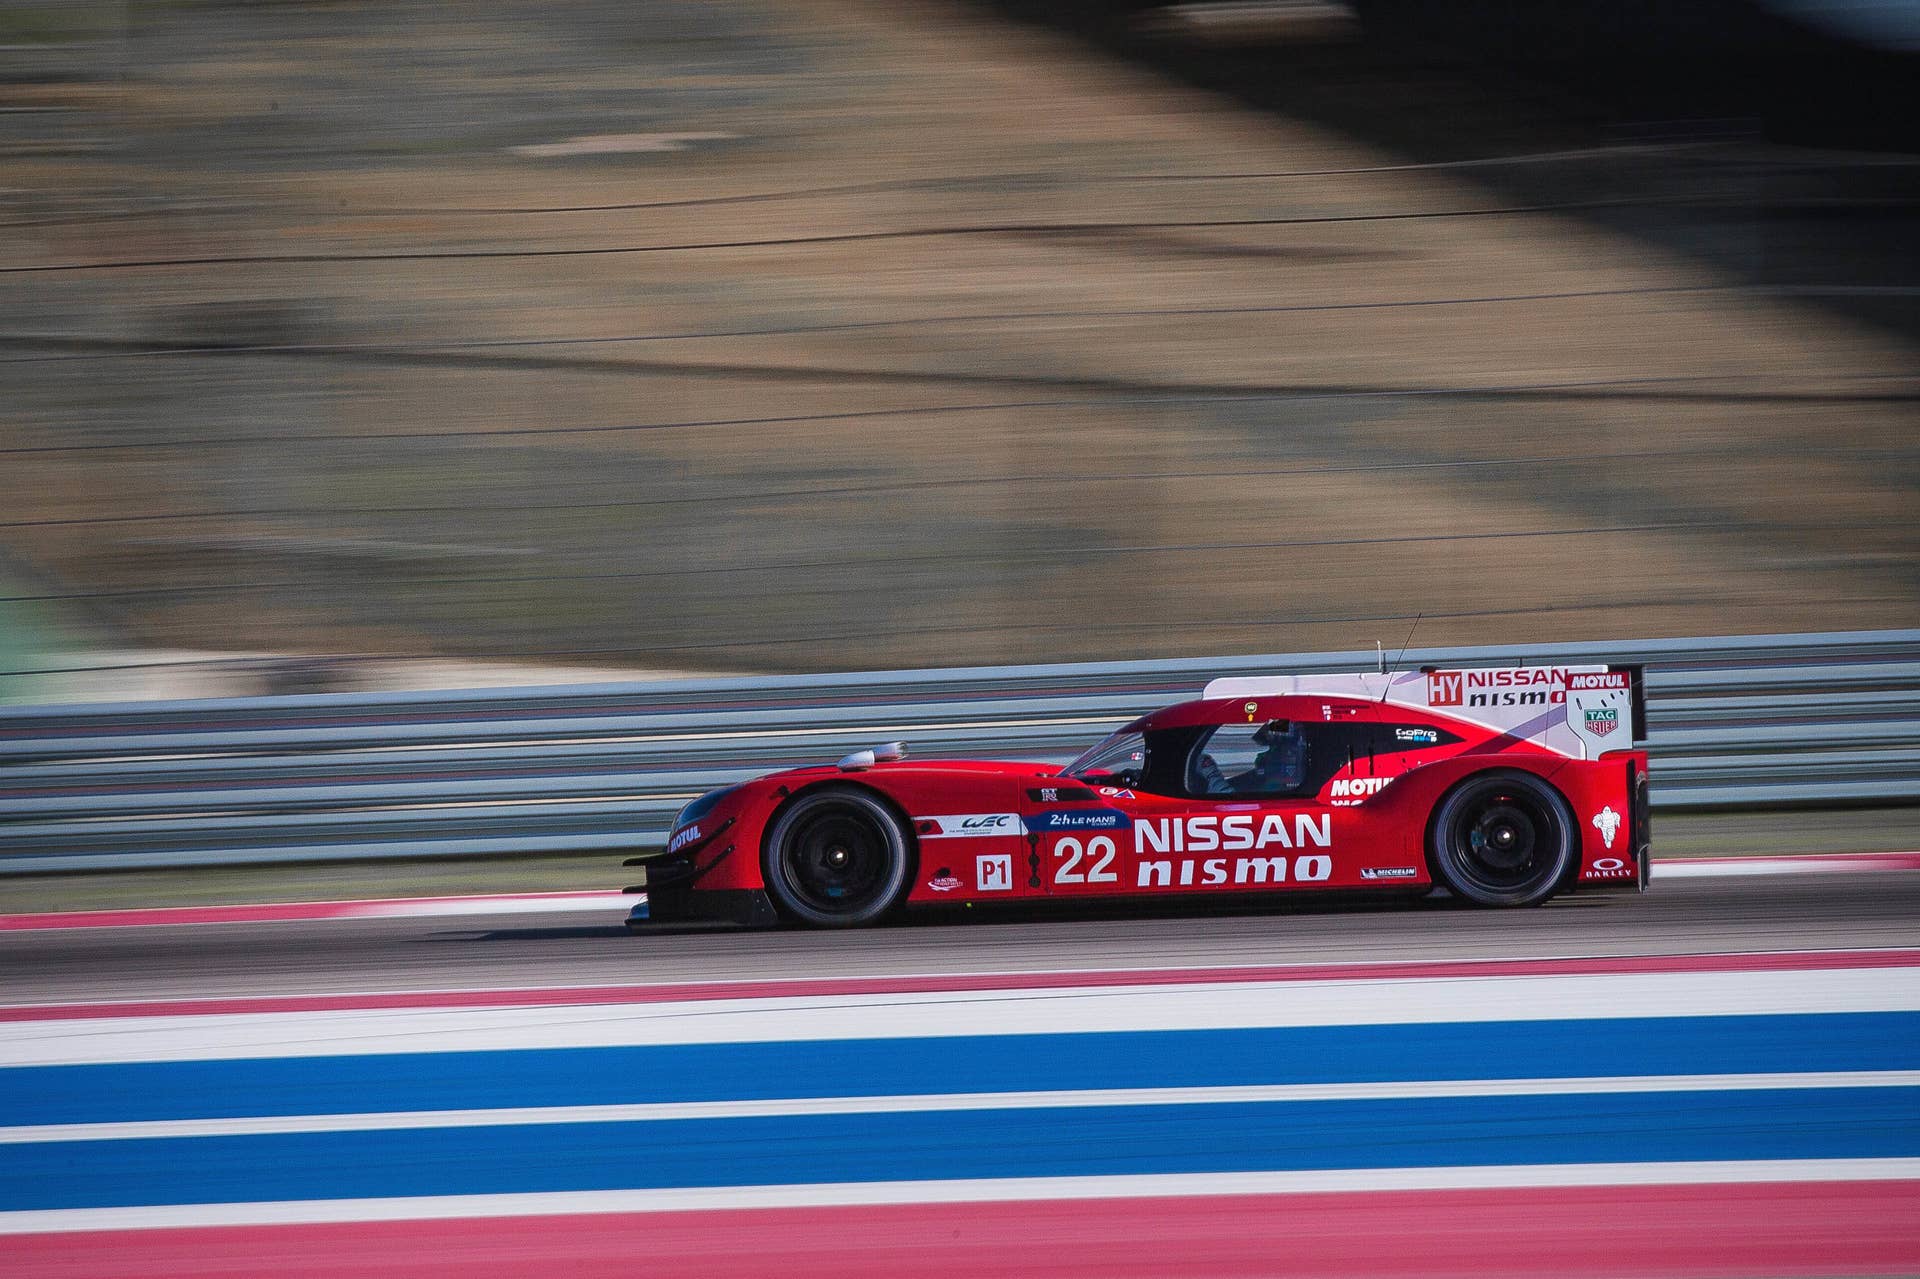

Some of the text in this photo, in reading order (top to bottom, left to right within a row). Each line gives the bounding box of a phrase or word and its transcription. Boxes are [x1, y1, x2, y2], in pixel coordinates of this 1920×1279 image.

[1468, 669, 1568, 687] NISSAN
[1571, 675, 1625, 688] MOTUL
[1429, 673, 1462, 703] HY
[1469, 691, 1567, 707] nismo
[1587, 711, 1615, 720] TAG
[1395, 728, 1437, 737] GoPro
[1587, 721, 1616, 734] HEUER
[1331, 777, 1394, 796] MOTU
[961, 815, 1010, 828] WEC
[1086, 815, 1116, 824] MANS
[670, 825, 702, 853] MOTUL
[1134, 813, 1331, 853] NISSAN
[1054, 835, 1118, 884] 22
[982, 860, 1006, 885] P1
[1137, 855, 1332, 887] nismo
[1377, 868, 1415, 876] MICHELIN
[1585, 869, 1631, 878] OAKLEY
